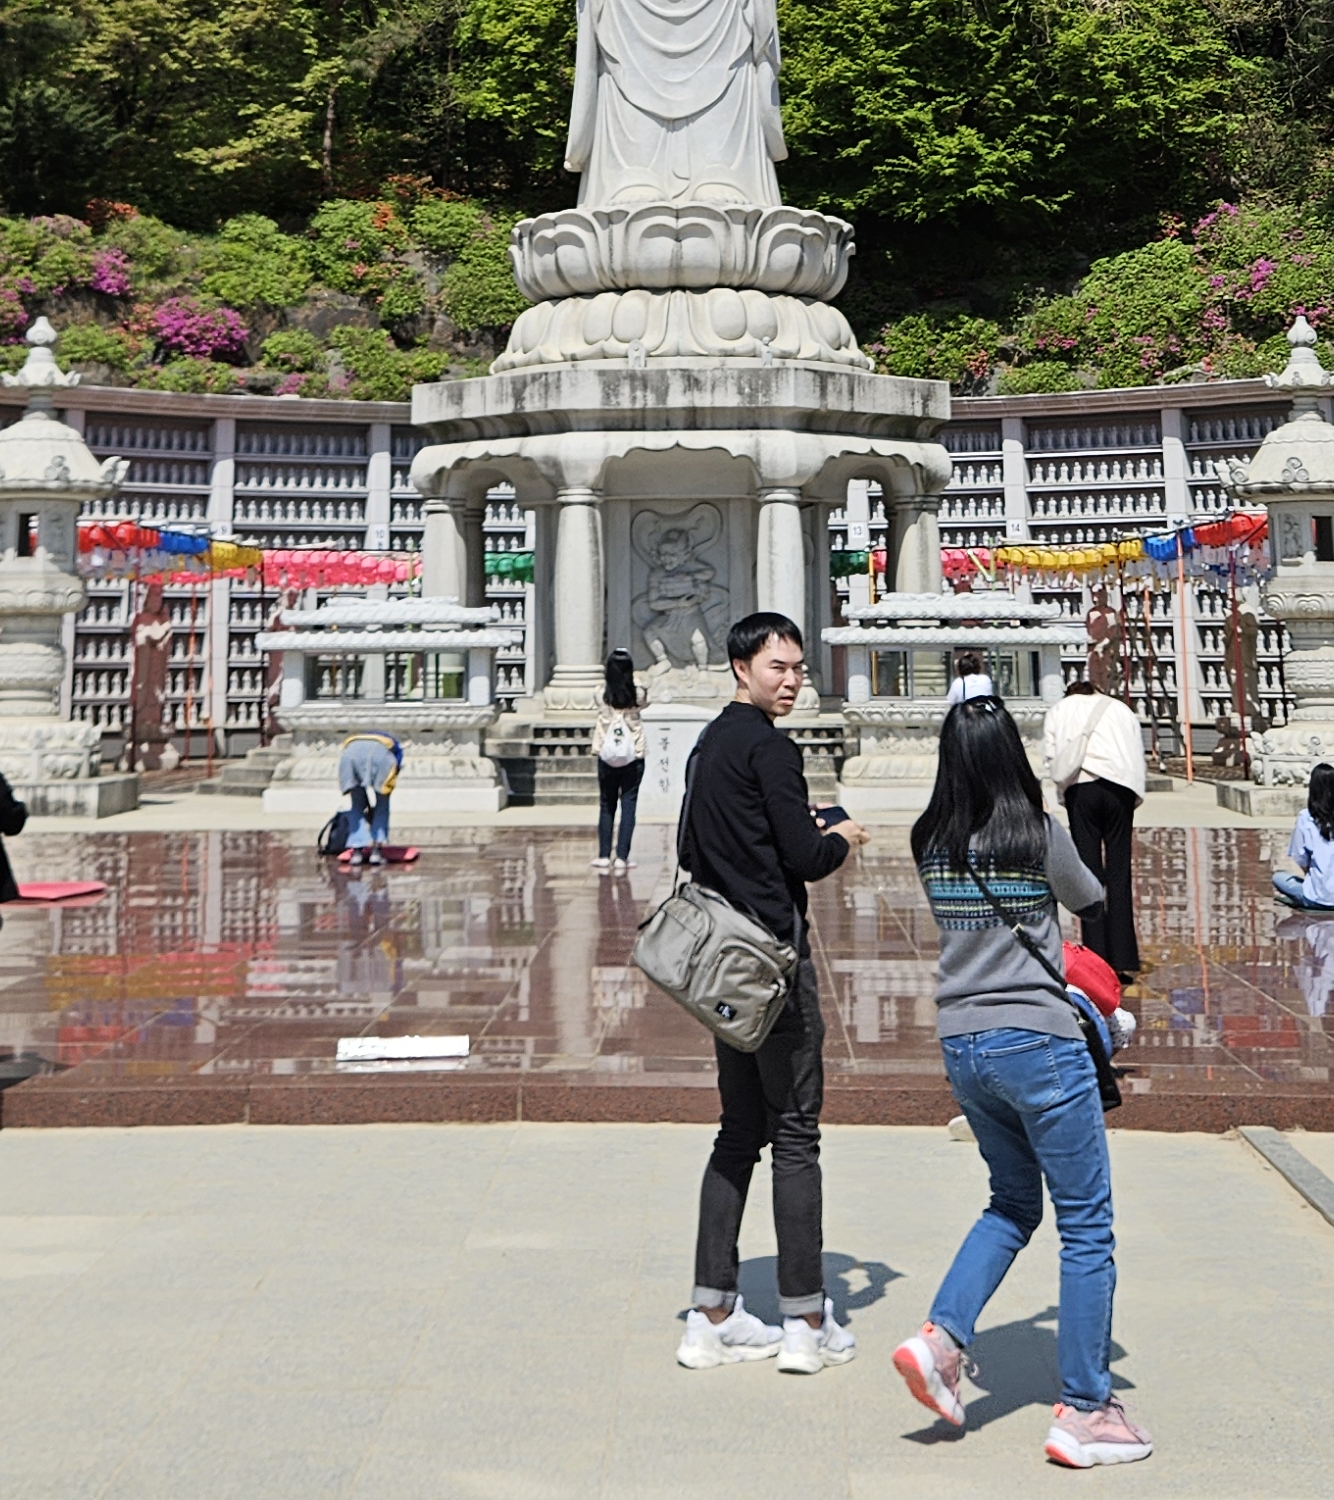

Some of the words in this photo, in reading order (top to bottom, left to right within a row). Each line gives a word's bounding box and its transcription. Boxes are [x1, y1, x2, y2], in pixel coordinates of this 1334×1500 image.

[853, 525, 862, 536] 13
[1011, 523, 1020, 532] 14
[375, 529, 385, 539] 10
